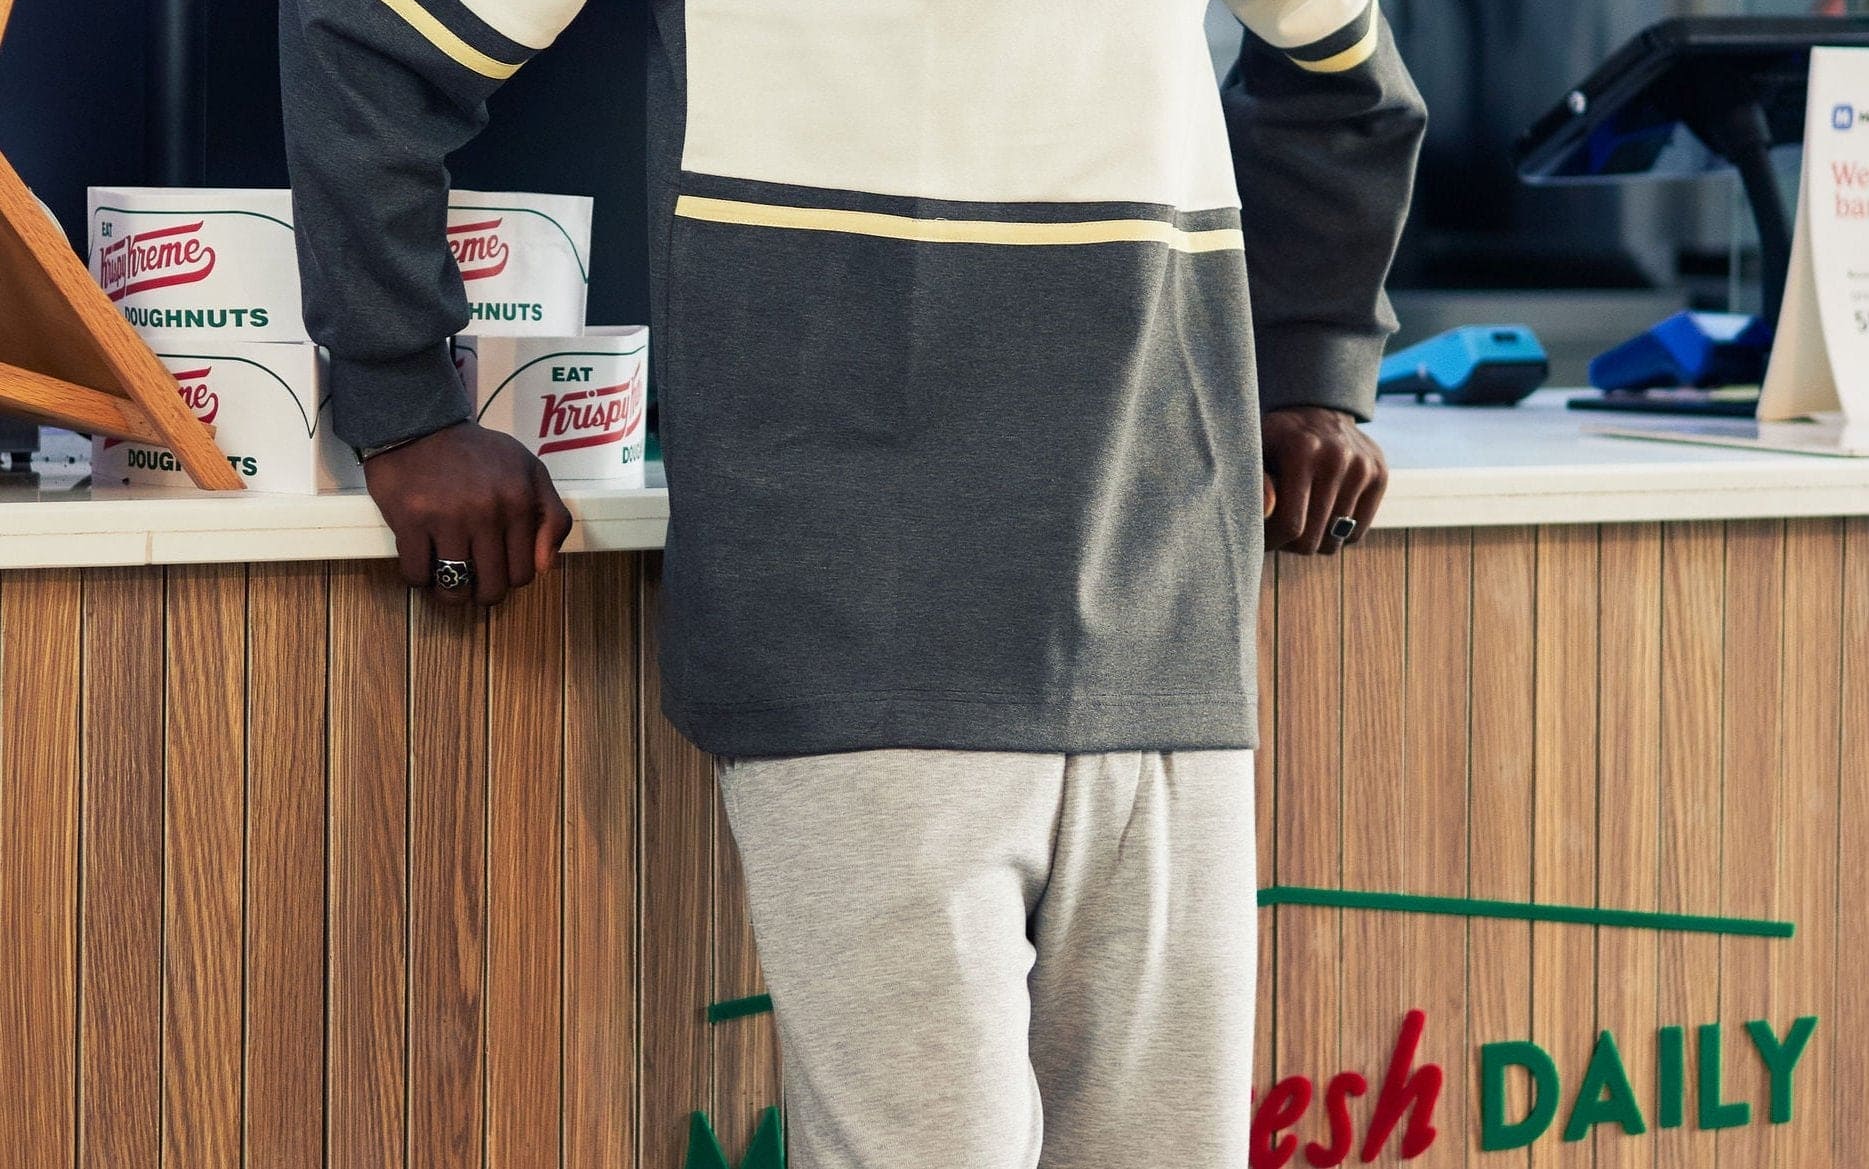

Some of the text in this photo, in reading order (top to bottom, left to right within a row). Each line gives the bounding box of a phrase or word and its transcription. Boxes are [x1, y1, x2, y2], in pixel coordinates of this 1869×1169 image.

[124, 306, 269, 329] DOUGHNUTS
[466, 302, 543, 321] HNUTS
[551, 367, 594, 382] EAT
[1249, 1008, 1819, 1169] esh DAILY
